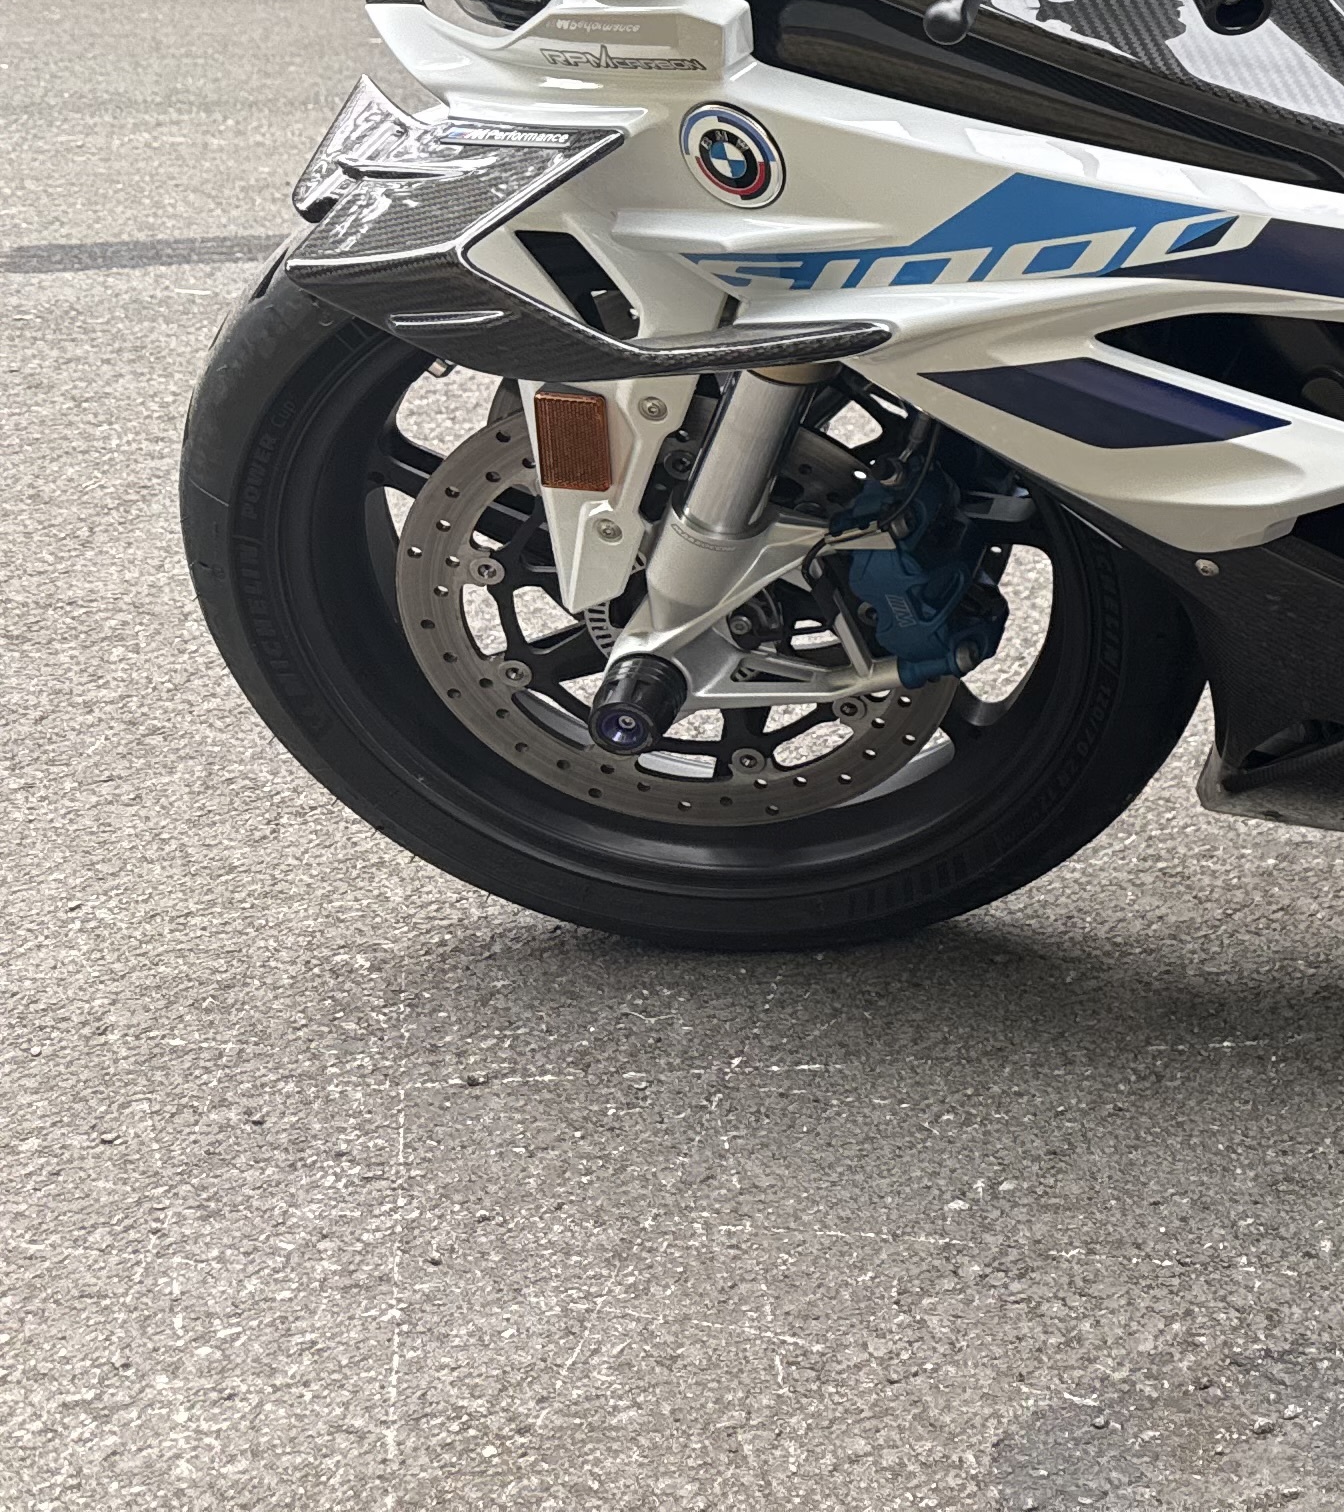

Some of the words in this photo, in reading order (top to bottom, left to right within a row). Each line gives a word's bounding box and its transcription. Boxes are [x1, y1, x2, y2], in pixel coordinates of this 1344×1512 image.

[486, 130, 569, 142] Performance
[701, 131, 749, 152] BMW
[240, 433, 277, 520] POWER
